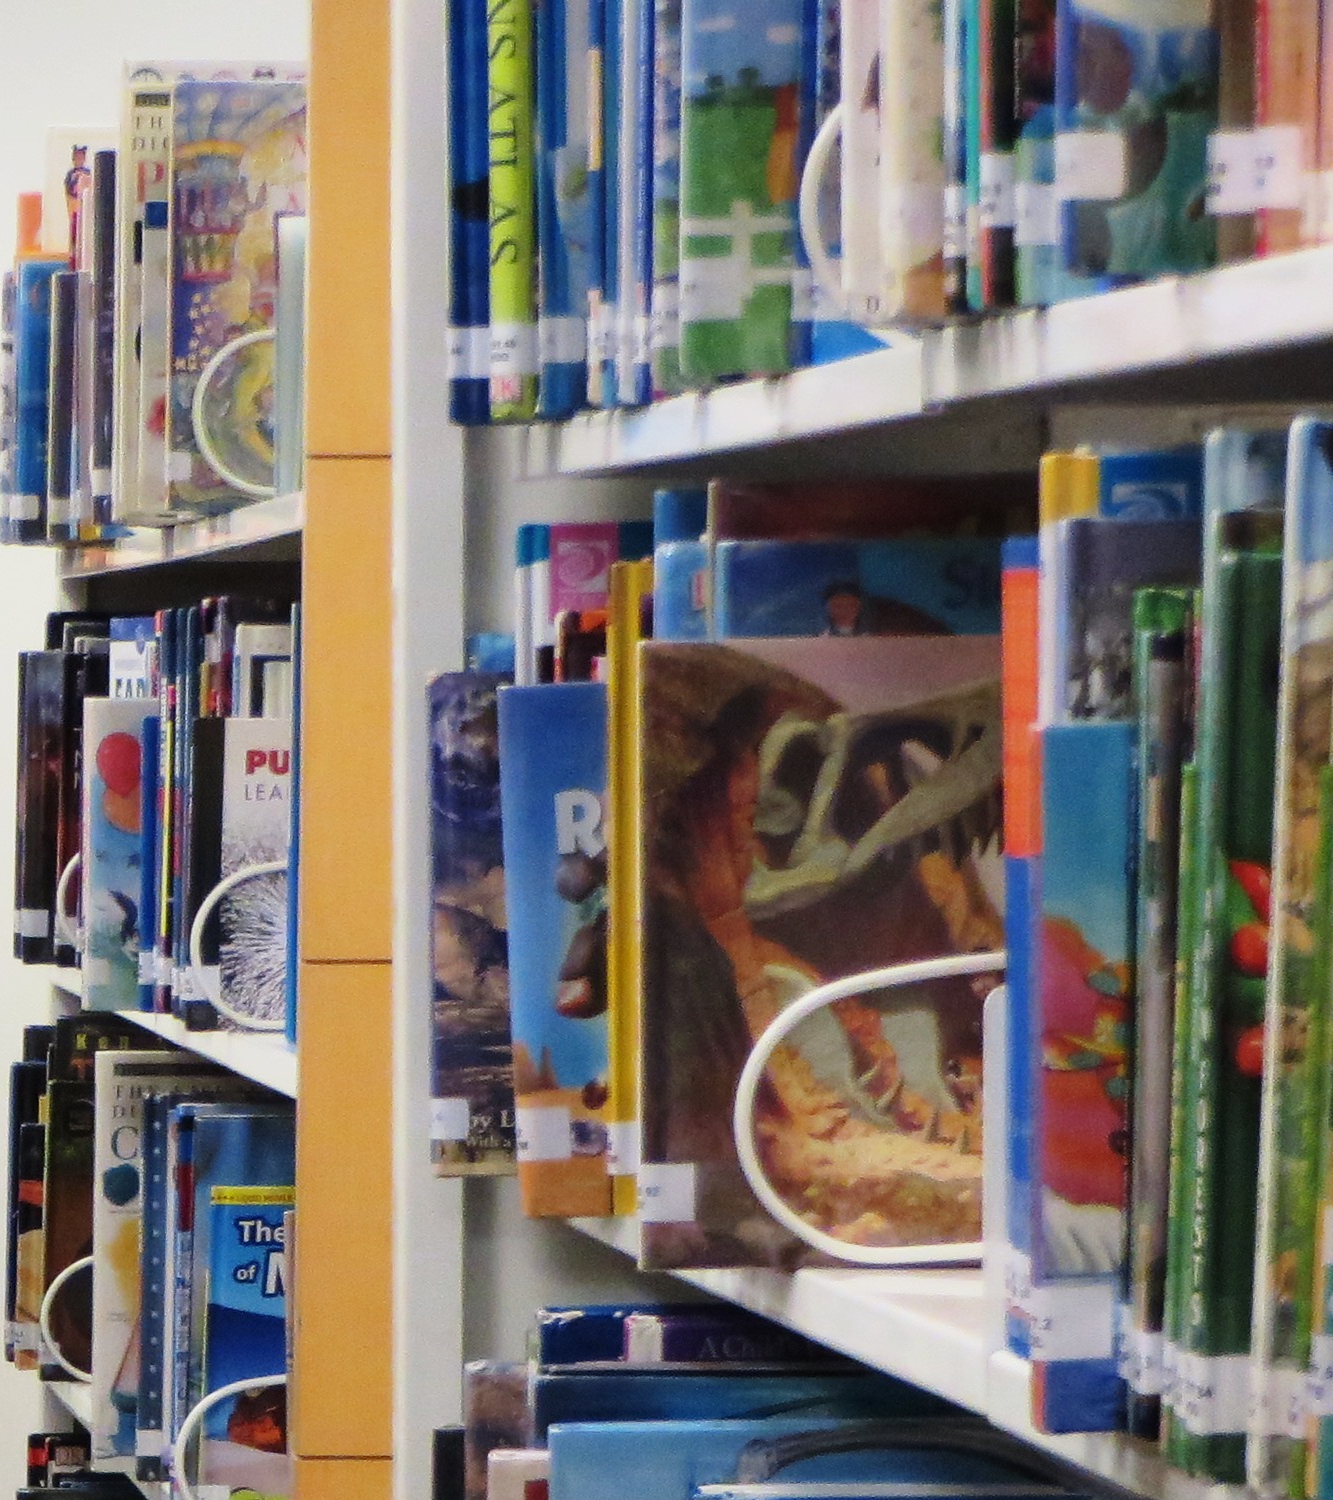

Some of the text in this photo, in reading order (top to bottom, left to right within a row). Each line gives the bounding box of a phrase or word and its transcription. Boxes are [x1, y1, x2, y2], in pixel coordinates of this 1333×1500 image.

[488, 90, 517, 268] ATLAS
[245, 749, 290, 775] PU
[244, 784, 289, 801] LEA
[554, 787, 610, 860] R
[238, 1219, 285, 1243] The
[236, 1265, 256, 1281] of
